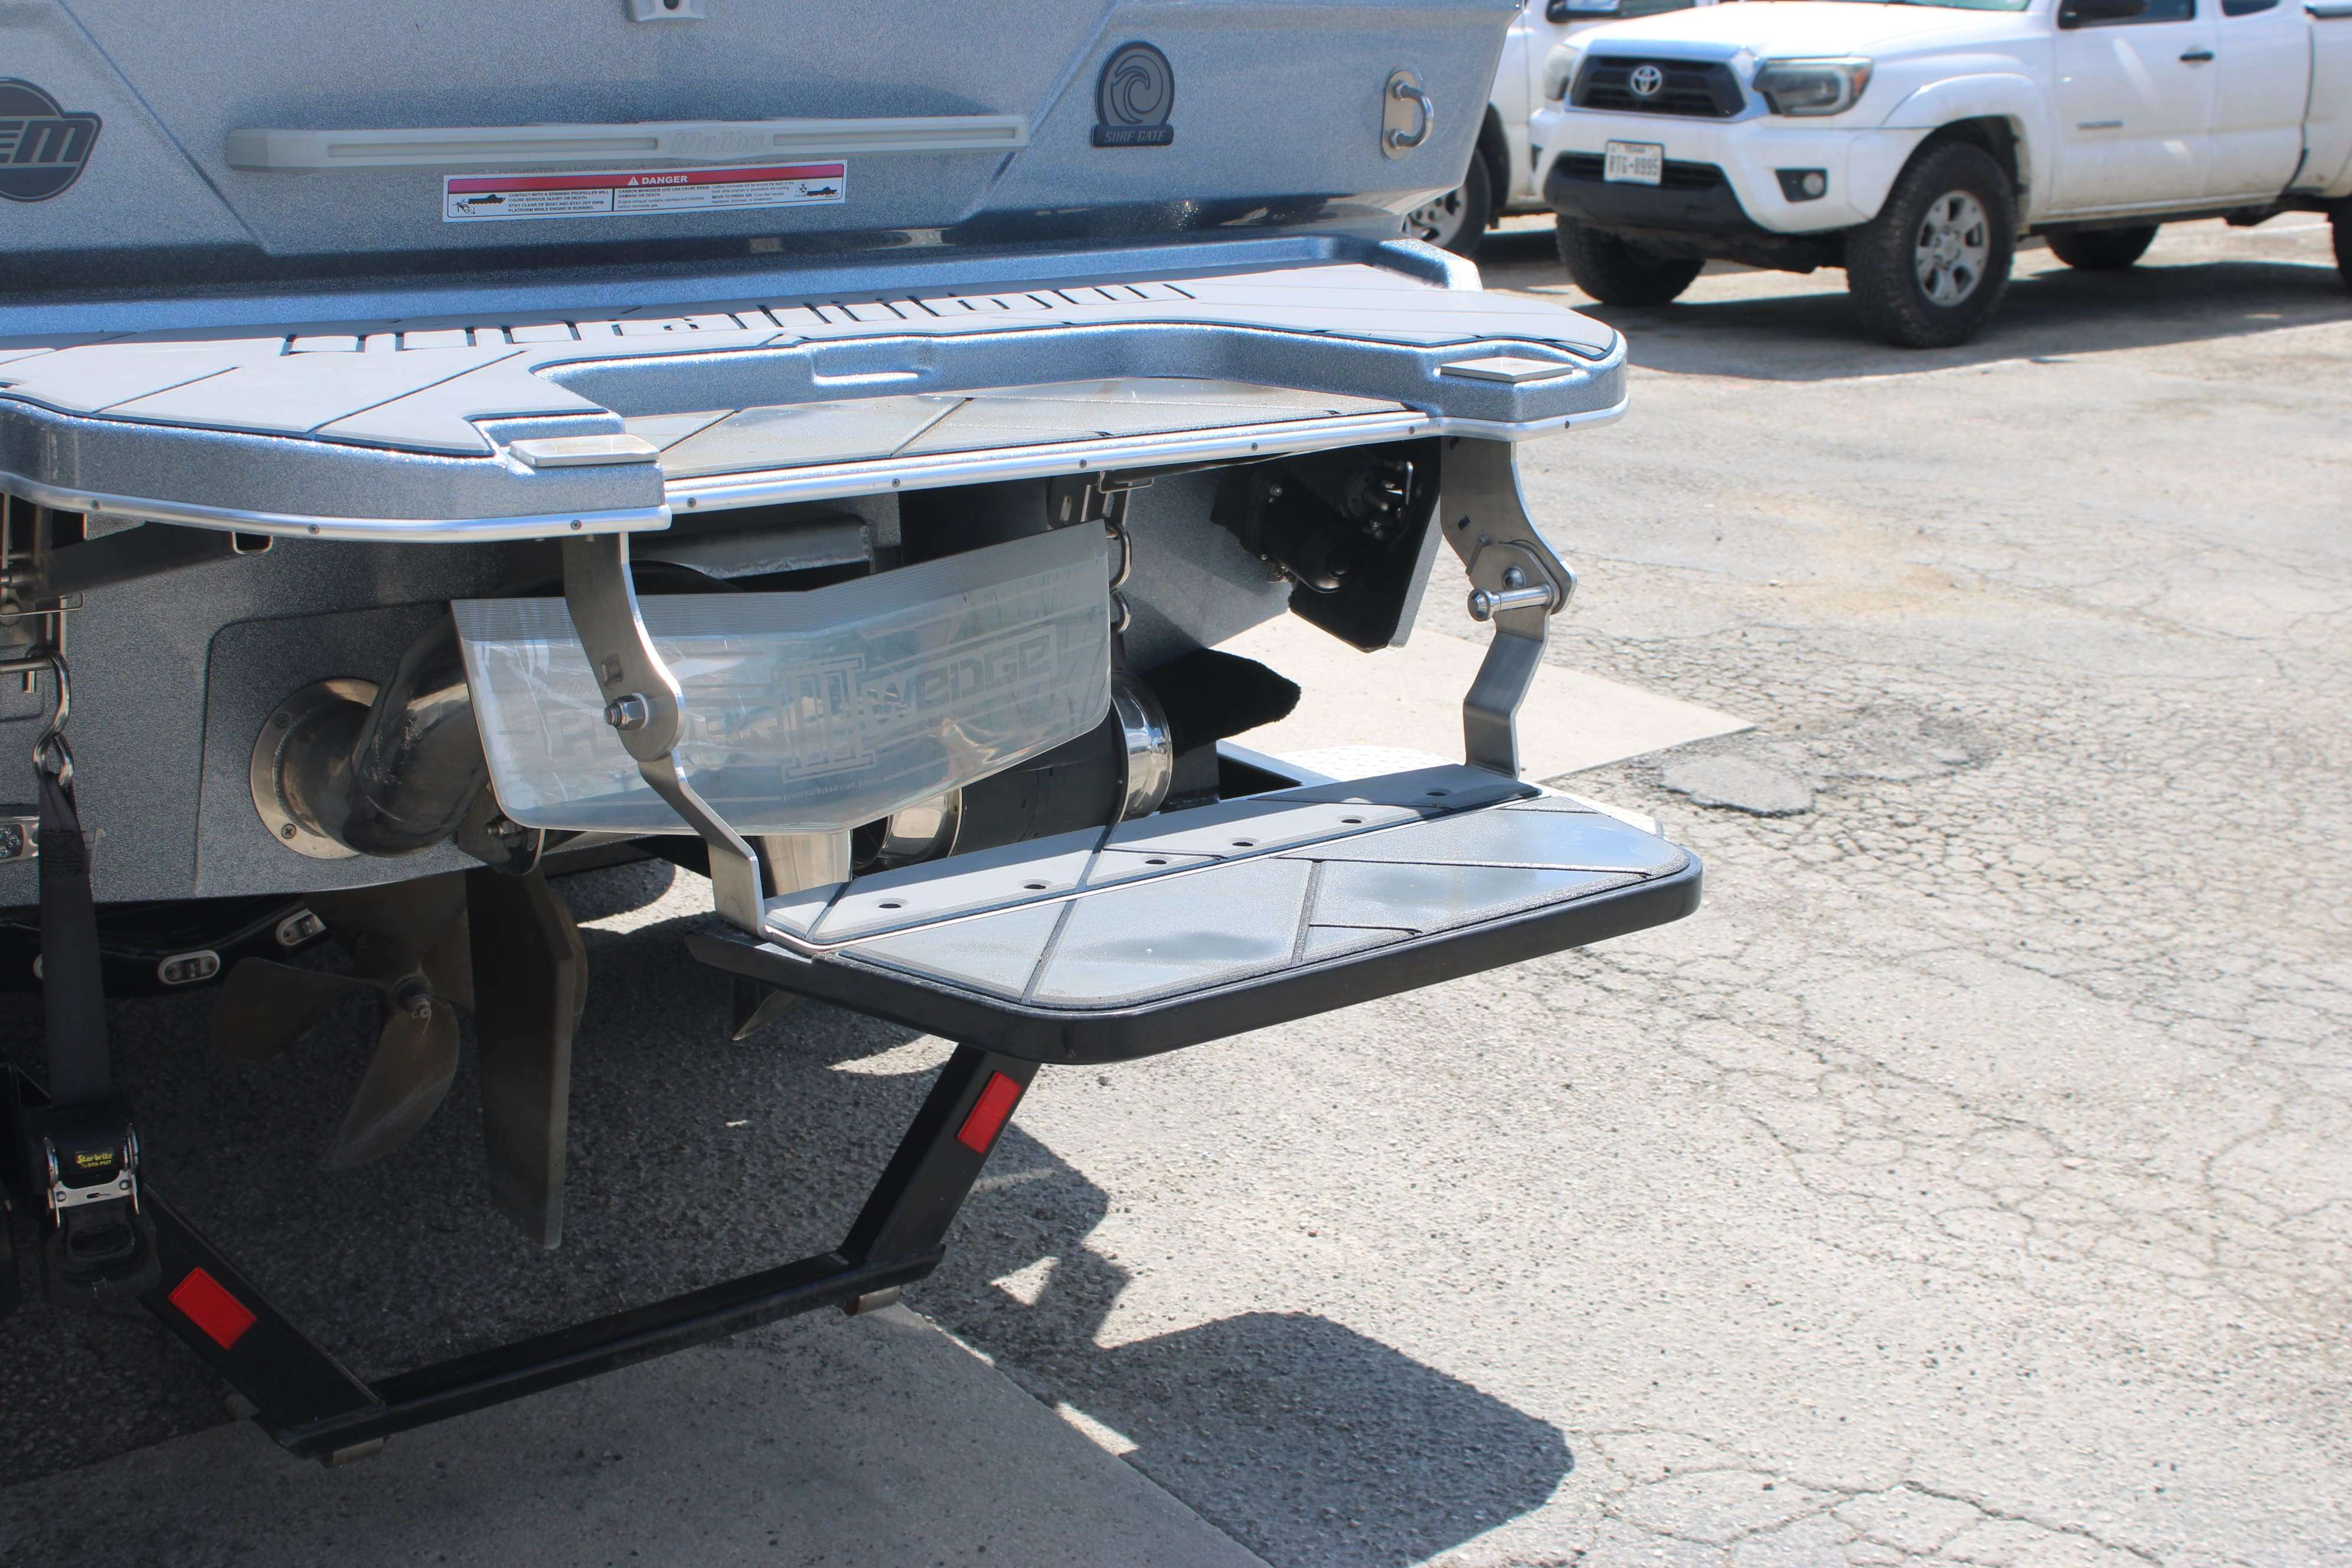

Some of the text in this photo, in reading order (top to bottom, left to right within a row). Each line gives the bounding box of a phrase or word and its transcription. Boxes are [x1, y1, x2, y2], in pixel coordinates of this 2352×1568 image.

[1105, 129, 1167, 142] SURF GATE
[642, 175, 688, 185] DANGER
